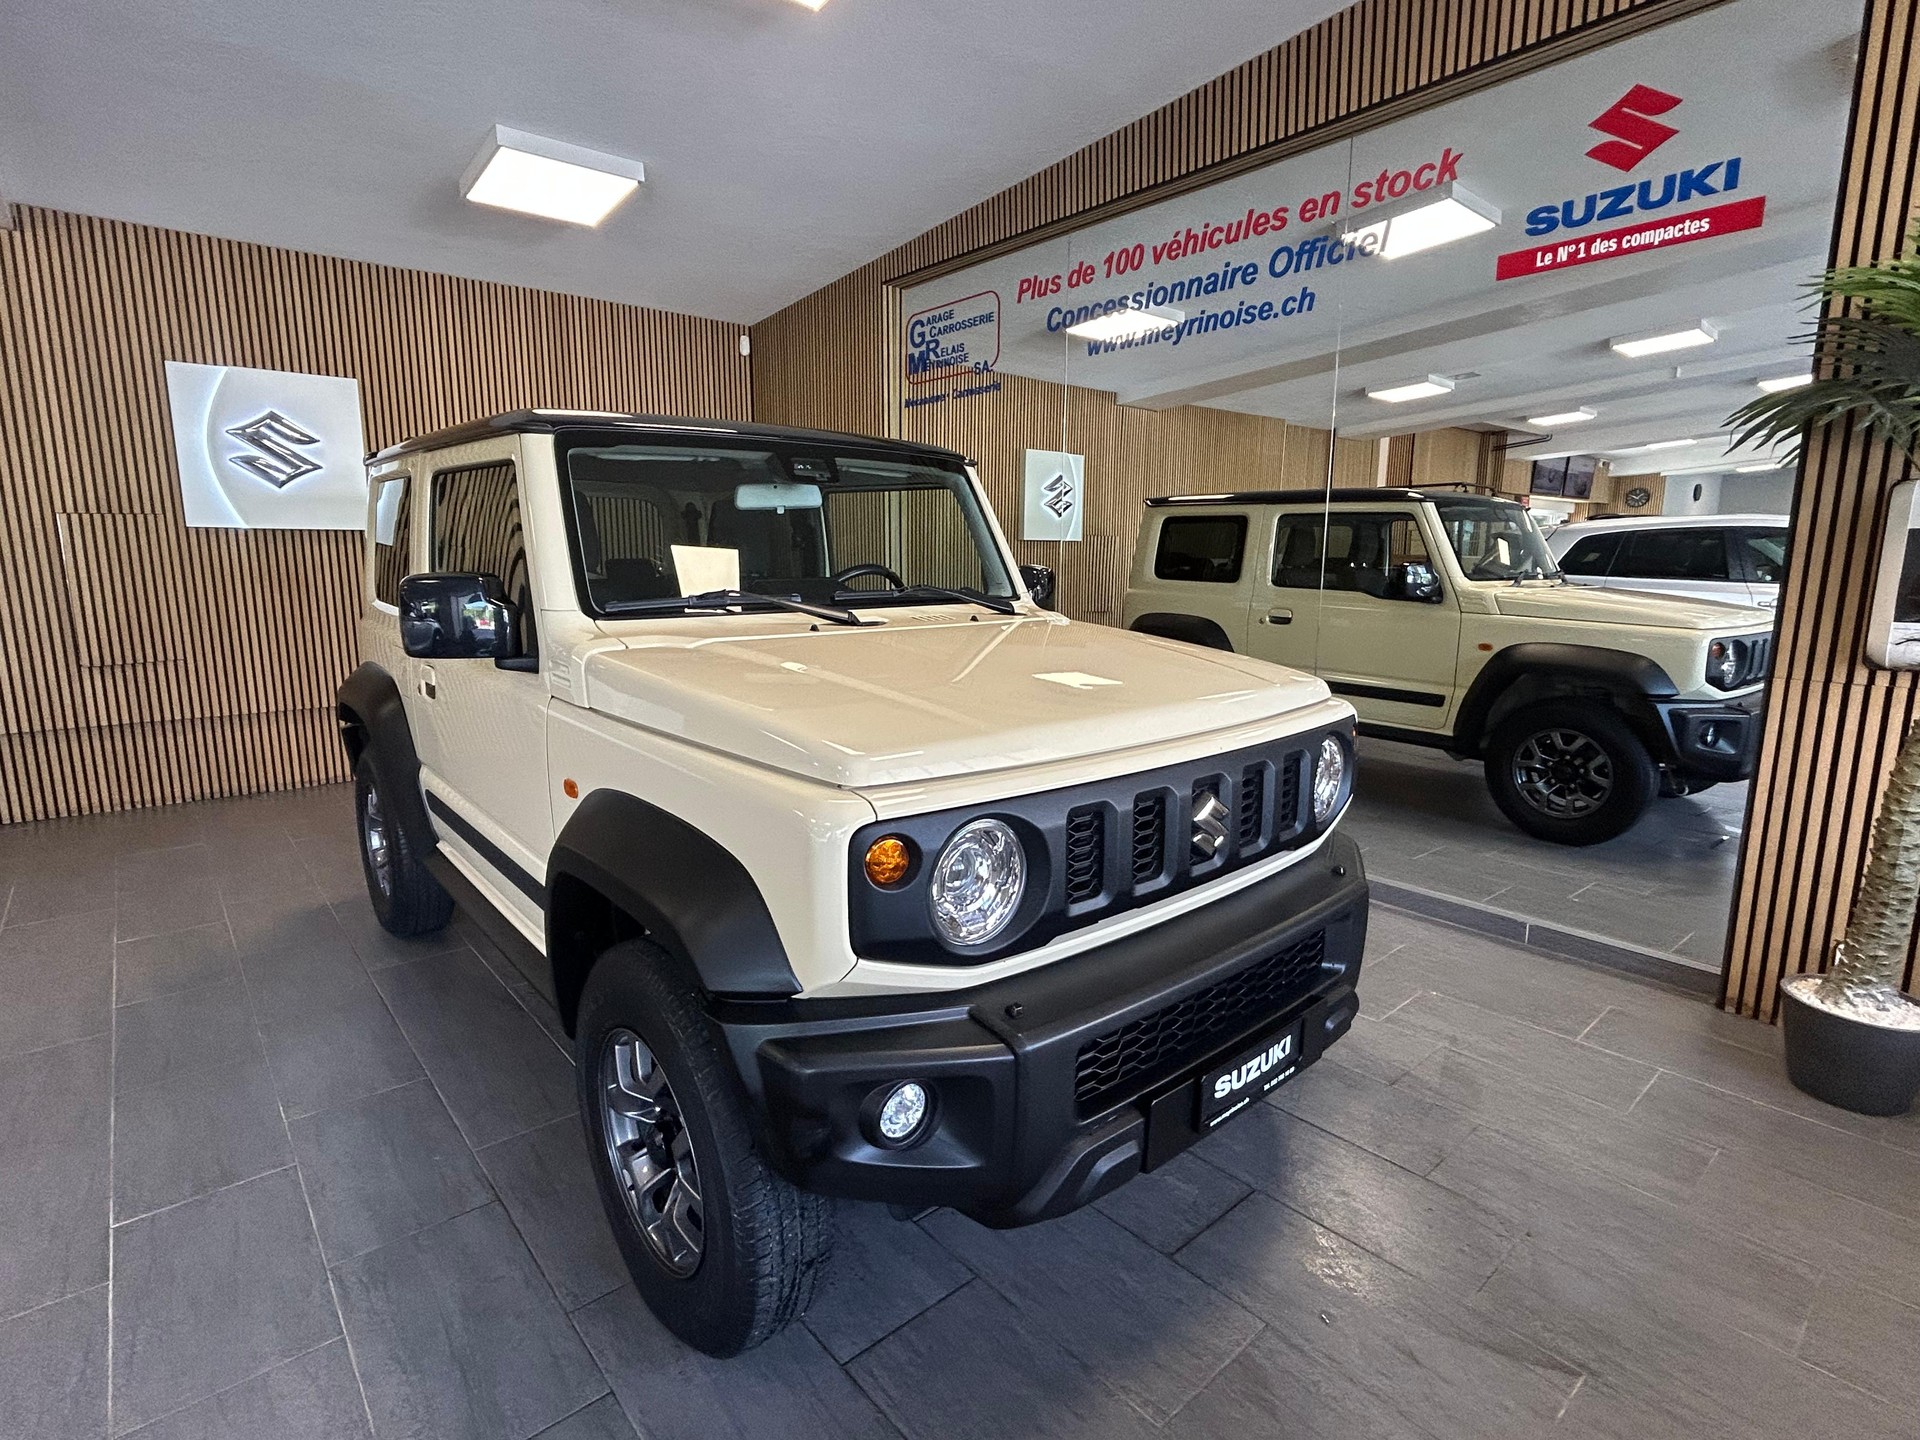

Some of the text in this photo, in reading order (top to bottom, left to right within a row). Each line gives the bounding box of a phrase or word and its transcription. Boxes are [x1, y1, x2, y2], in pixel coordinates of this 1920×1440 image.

[1016, 148, 1464, 304] Plus de 100 véhicules en stock
[1525, 157, 1741, 236] SUZUKI
[1046, 218, 1392, 333] Concessionnaire Officiel
[1535, 251, 1552, 268] Le
[1590, 238, 1617, 256] des
[1621, 217, 1710, 246] compactes
[929, 311, 995, 338] CARROSSERIE
[1087, 286, 1316, 357] www.meyrinoise.ch
[1214, 1034, 1292, 1099] SUZUKI
